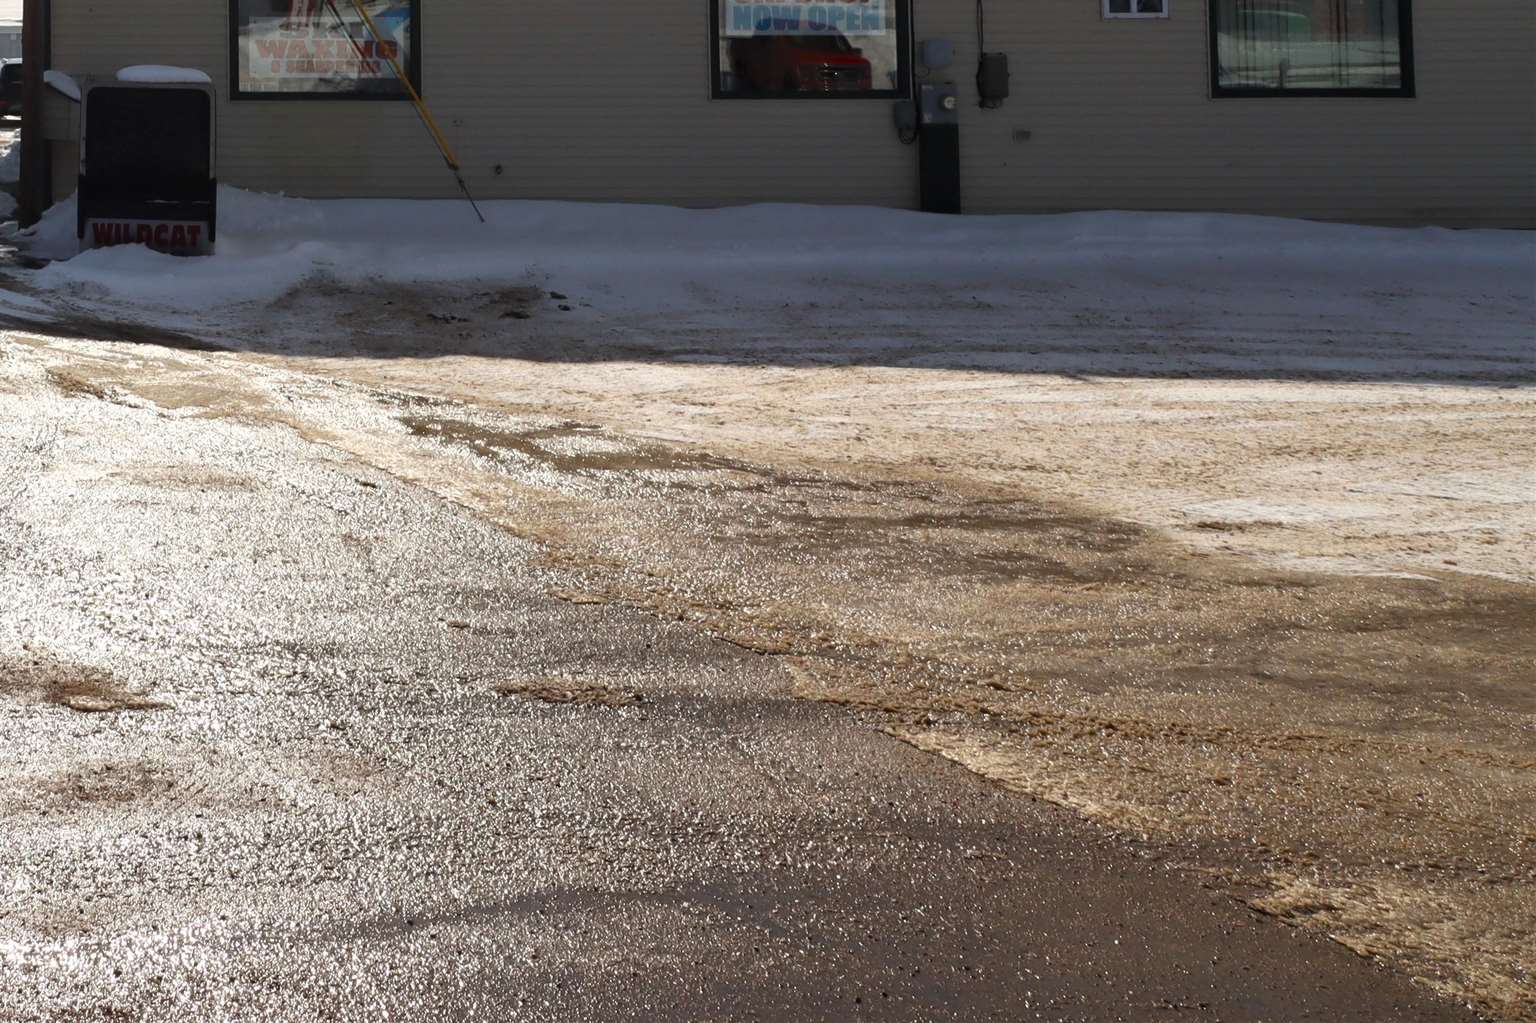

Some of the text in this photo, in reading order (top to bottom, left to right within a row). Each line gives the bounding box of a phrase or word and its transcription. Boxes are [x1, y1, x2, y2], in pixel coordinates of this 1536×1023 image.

[733, 6, 880, 31] NOW OPEN
[255, 39, 397, 59] WAXING
[93, 223, 201, 247] WILDCAT
